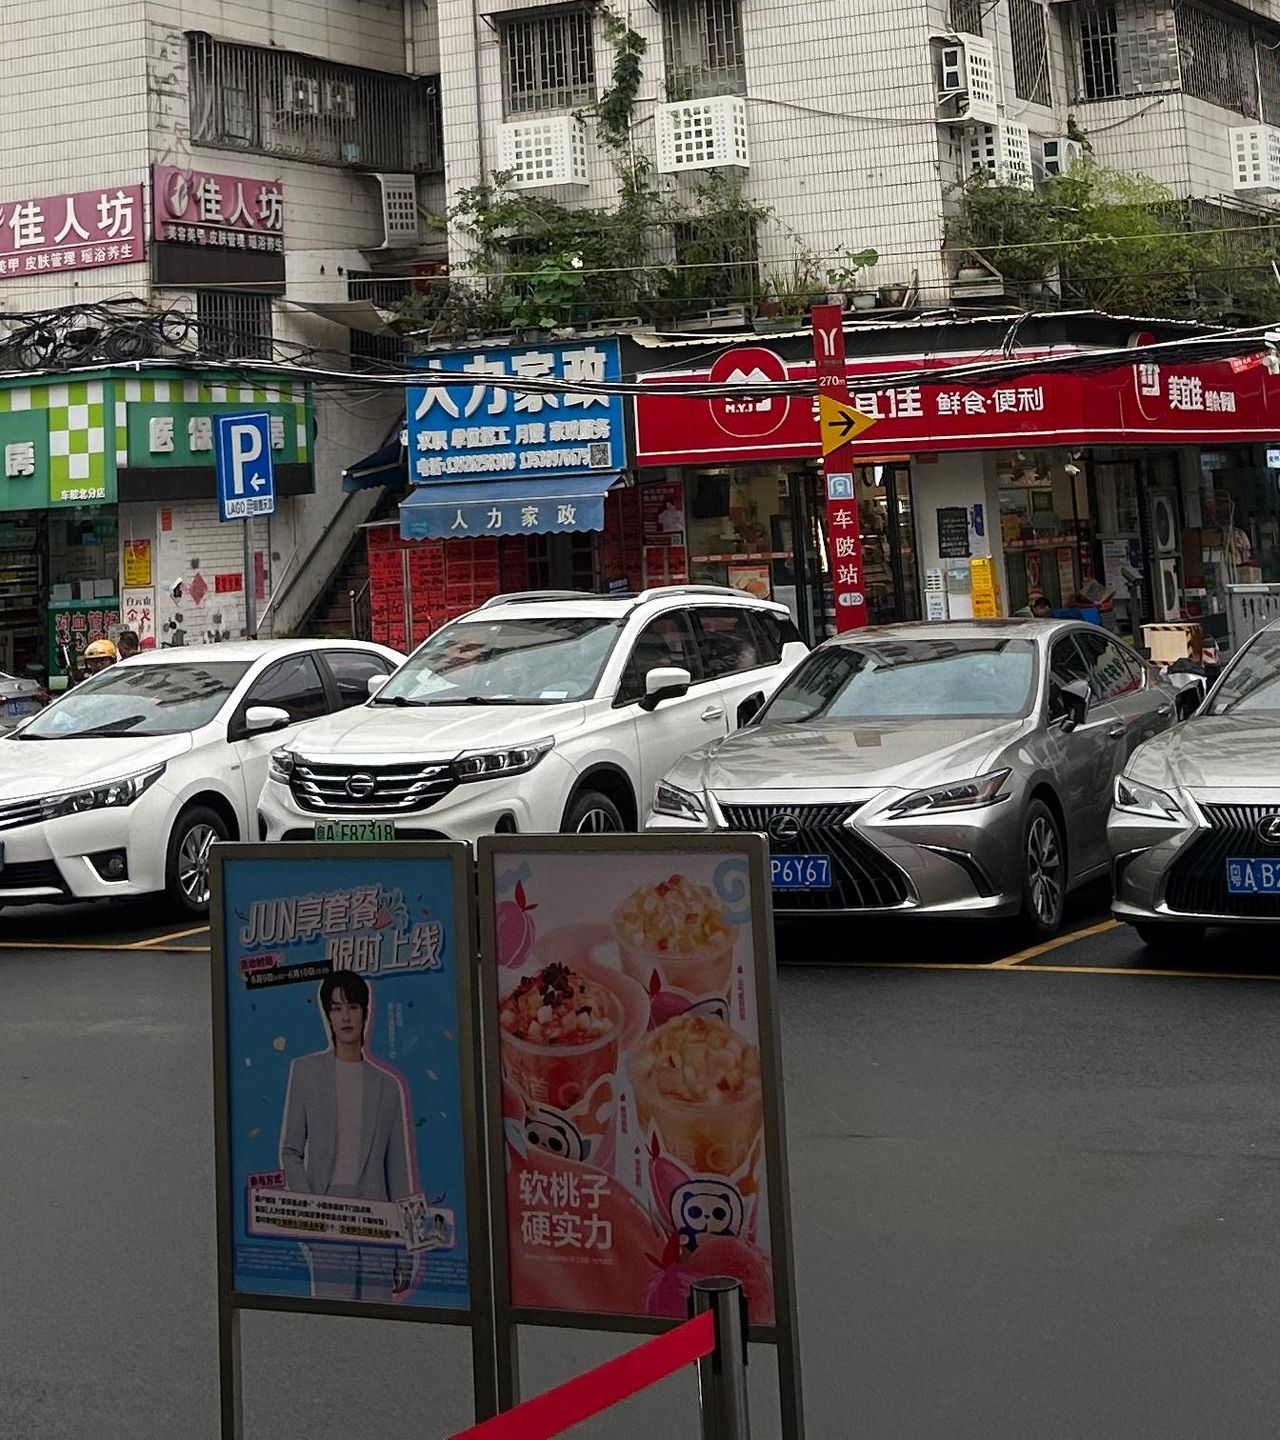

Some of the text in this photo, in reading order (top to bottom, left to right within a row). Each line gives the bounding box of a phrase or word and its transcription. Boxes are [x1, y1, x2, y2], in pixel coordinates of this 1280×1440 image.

[9, 190, 134, 249] 佳人坊
[195, 177, 283, 230] 佳人坊
[168, 225, 206, 243] 美容美甲
[210, 229, 245, 249] 皮肤管理
[25, 250, 76, 271] 皮肤管理
[416, 347, 610, 420] 人力家政
[1168, 376, 1204, 411] 美宜佳
[812, 386, 924, 421] 宜佳
[148, 416, 285, 453] 医保房
[231, 424, 262, 495] P
[227, 501, 246, 515] LAGO
[451, 504, 576, 530] 人力家政
[833, 509, 857, 585] 车陂站
[771, 860, 828, 883] P6Y67
[240, 886, 380, 943] JUN享套餐
[328, 924, 441, 972] 限时上线
[519, 1170, 611, 1210] 软桃子
[520, 1211, 613, 1250] 硬实力
